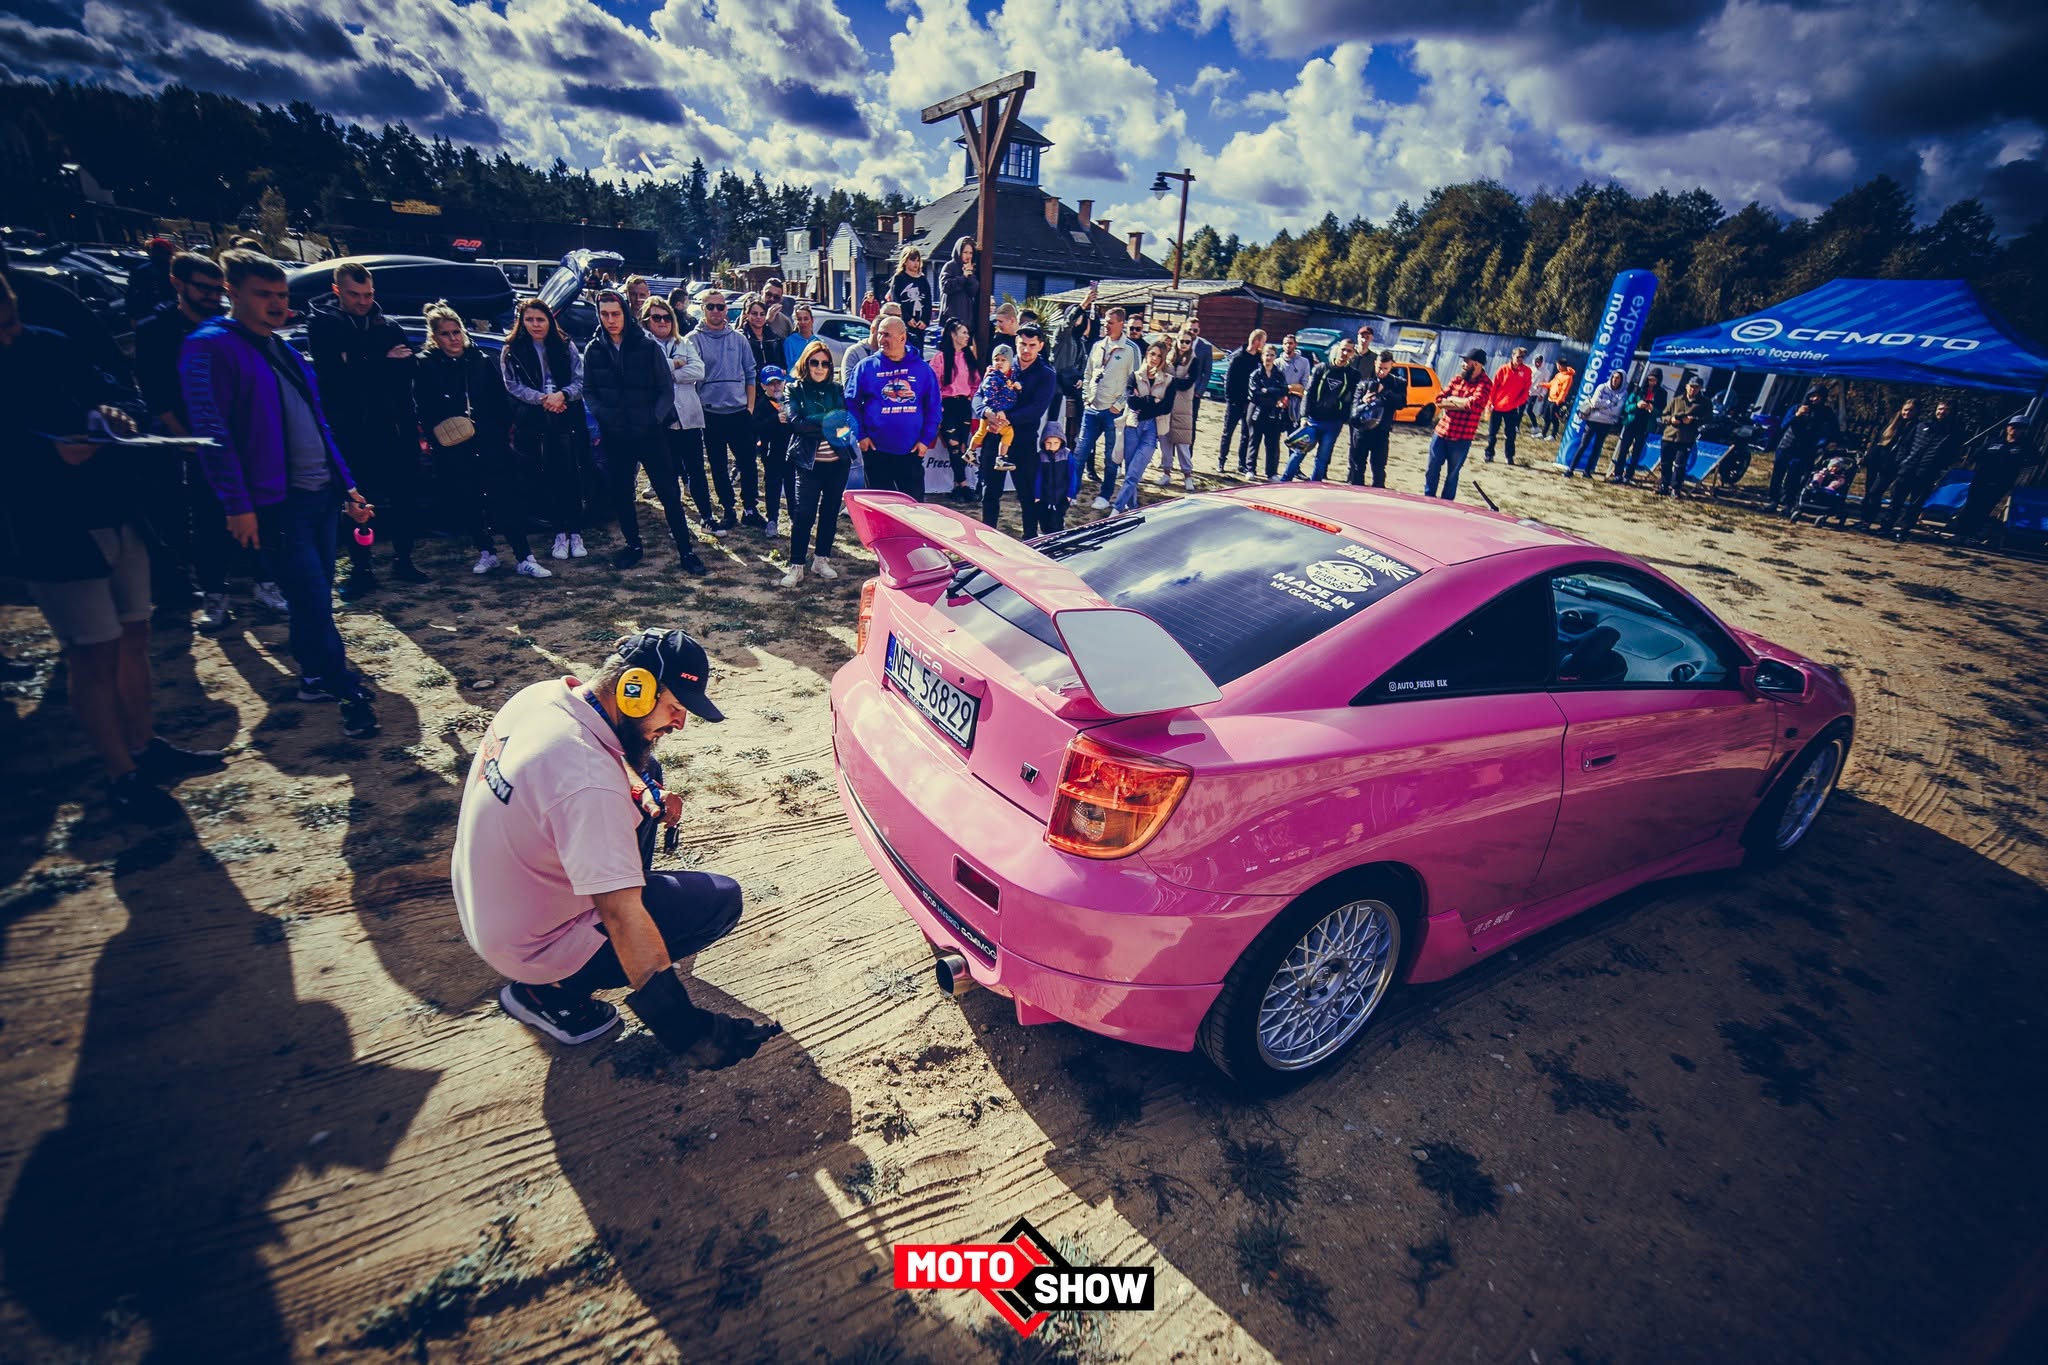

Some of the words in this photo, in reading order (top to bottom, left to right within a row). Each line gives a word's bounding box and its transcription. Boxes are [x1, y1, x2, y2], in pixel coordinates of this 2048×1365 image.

[1599, 292, 1625, 345] more
[1768, 347, 1829, 361] together
[1787, 328, 1980, 351] CFMOTO
[1272, 572, 1334, 600] MADE
[1331, 595, 1355, 610] IN
[897, 630, 943, 674] CELICA
[893, 642, 915, 691] NEL
[920, 667, 971, 733] 56829
